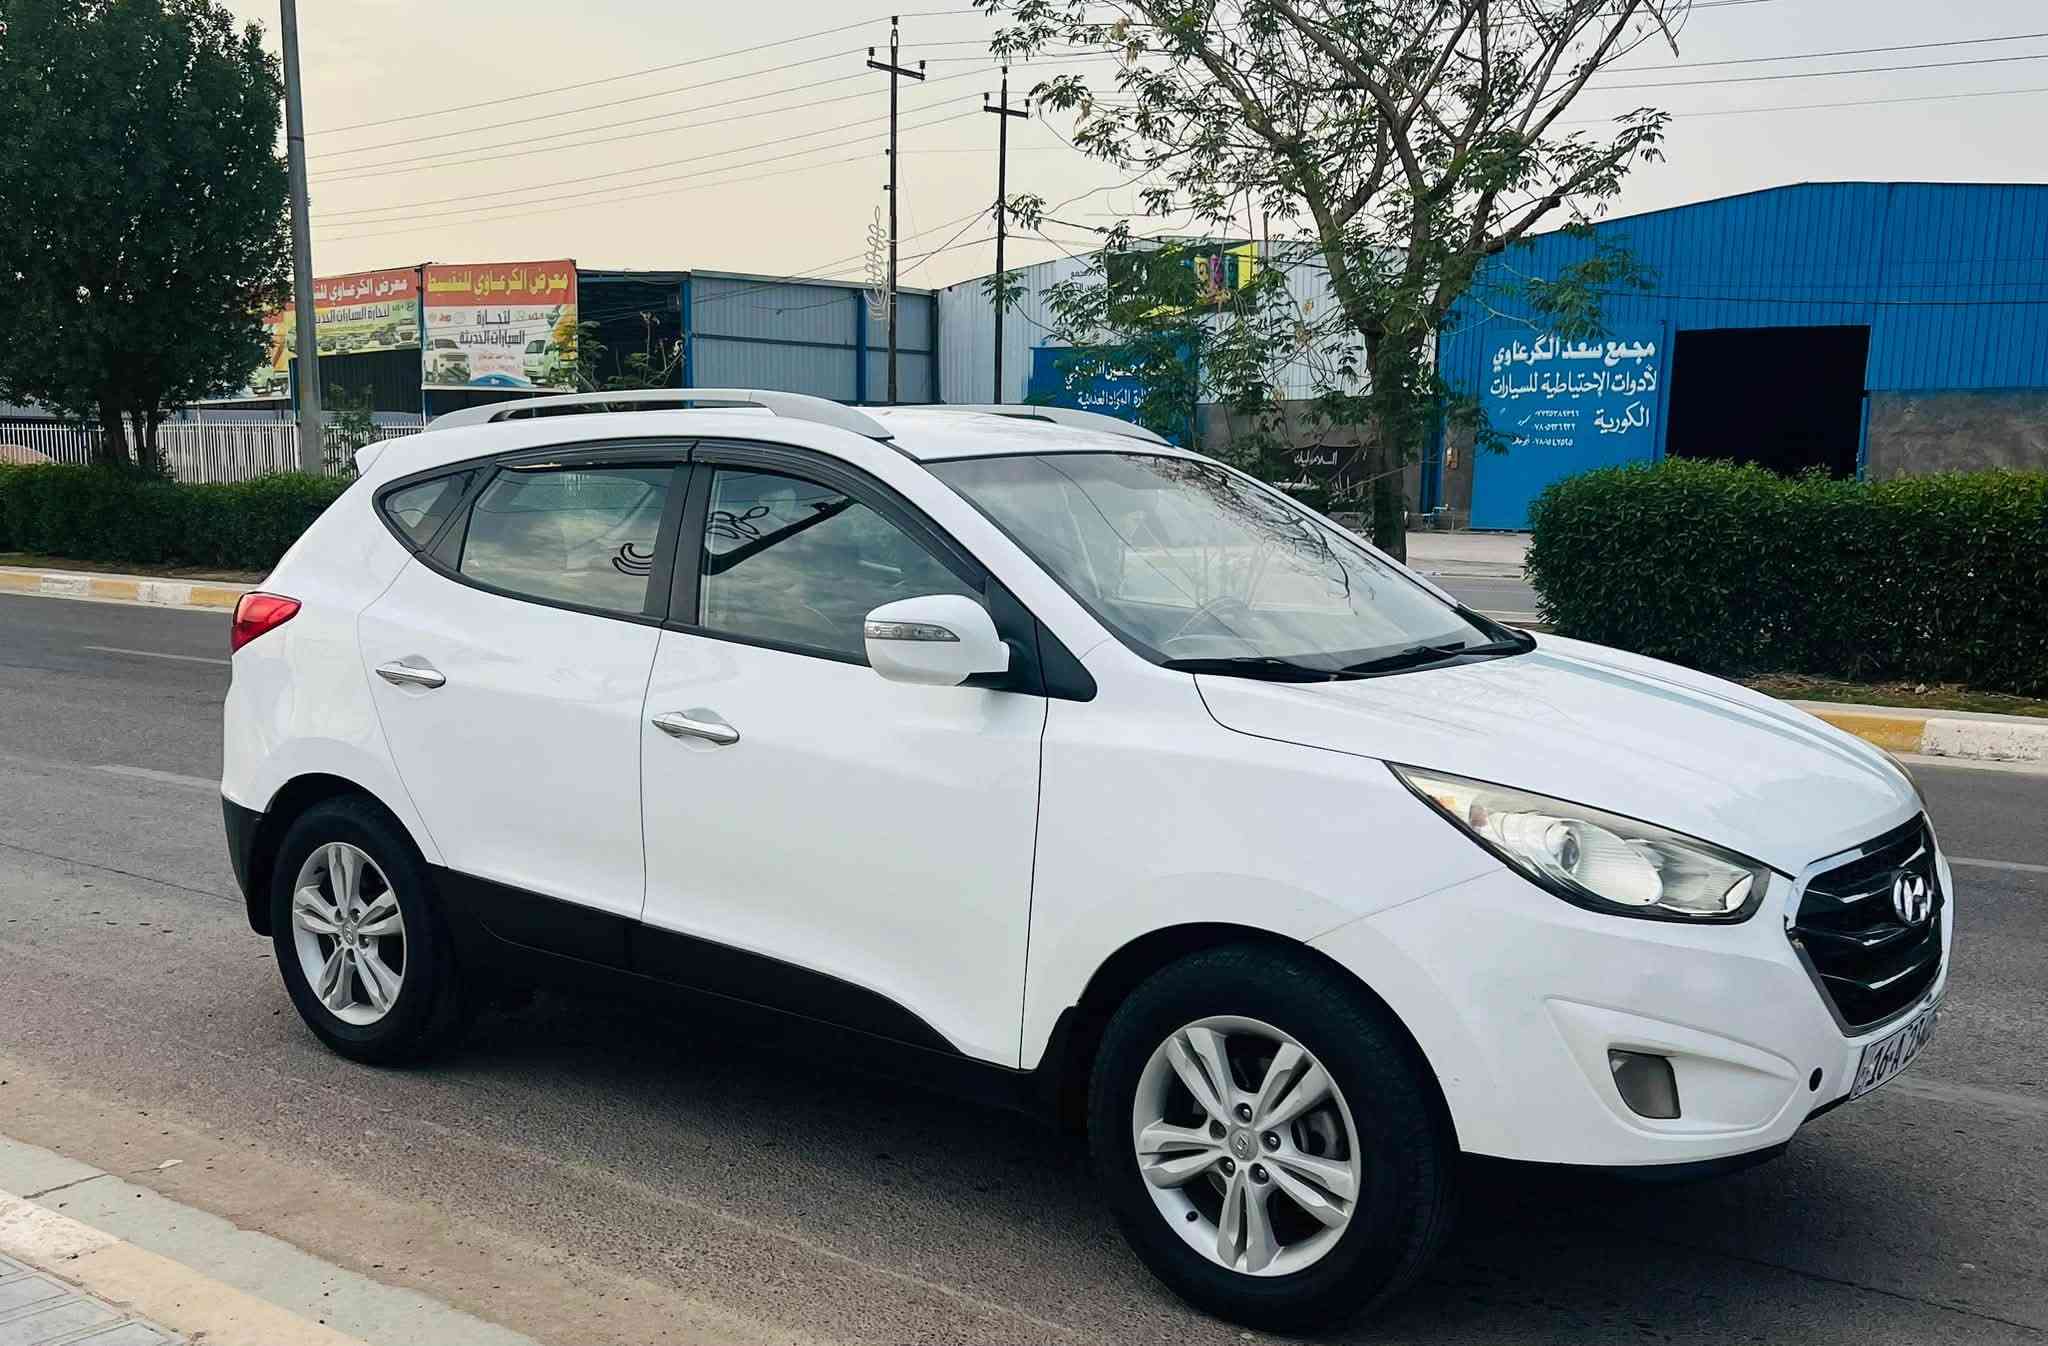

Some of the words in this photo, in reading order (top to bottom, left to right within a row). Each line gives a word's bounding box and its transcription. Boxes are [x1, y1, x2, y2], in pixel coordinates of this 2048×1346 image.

[375, 276, 408, 297] معرض
[530, 267, 569, 296] معرض
[1561, 341, 1604, 360] سعد
[1604, 341, 1657, 367] مجمع
[1490, 371, 1538, 399] للسيارات
[1593, 401, 1650, 434] الكورية
